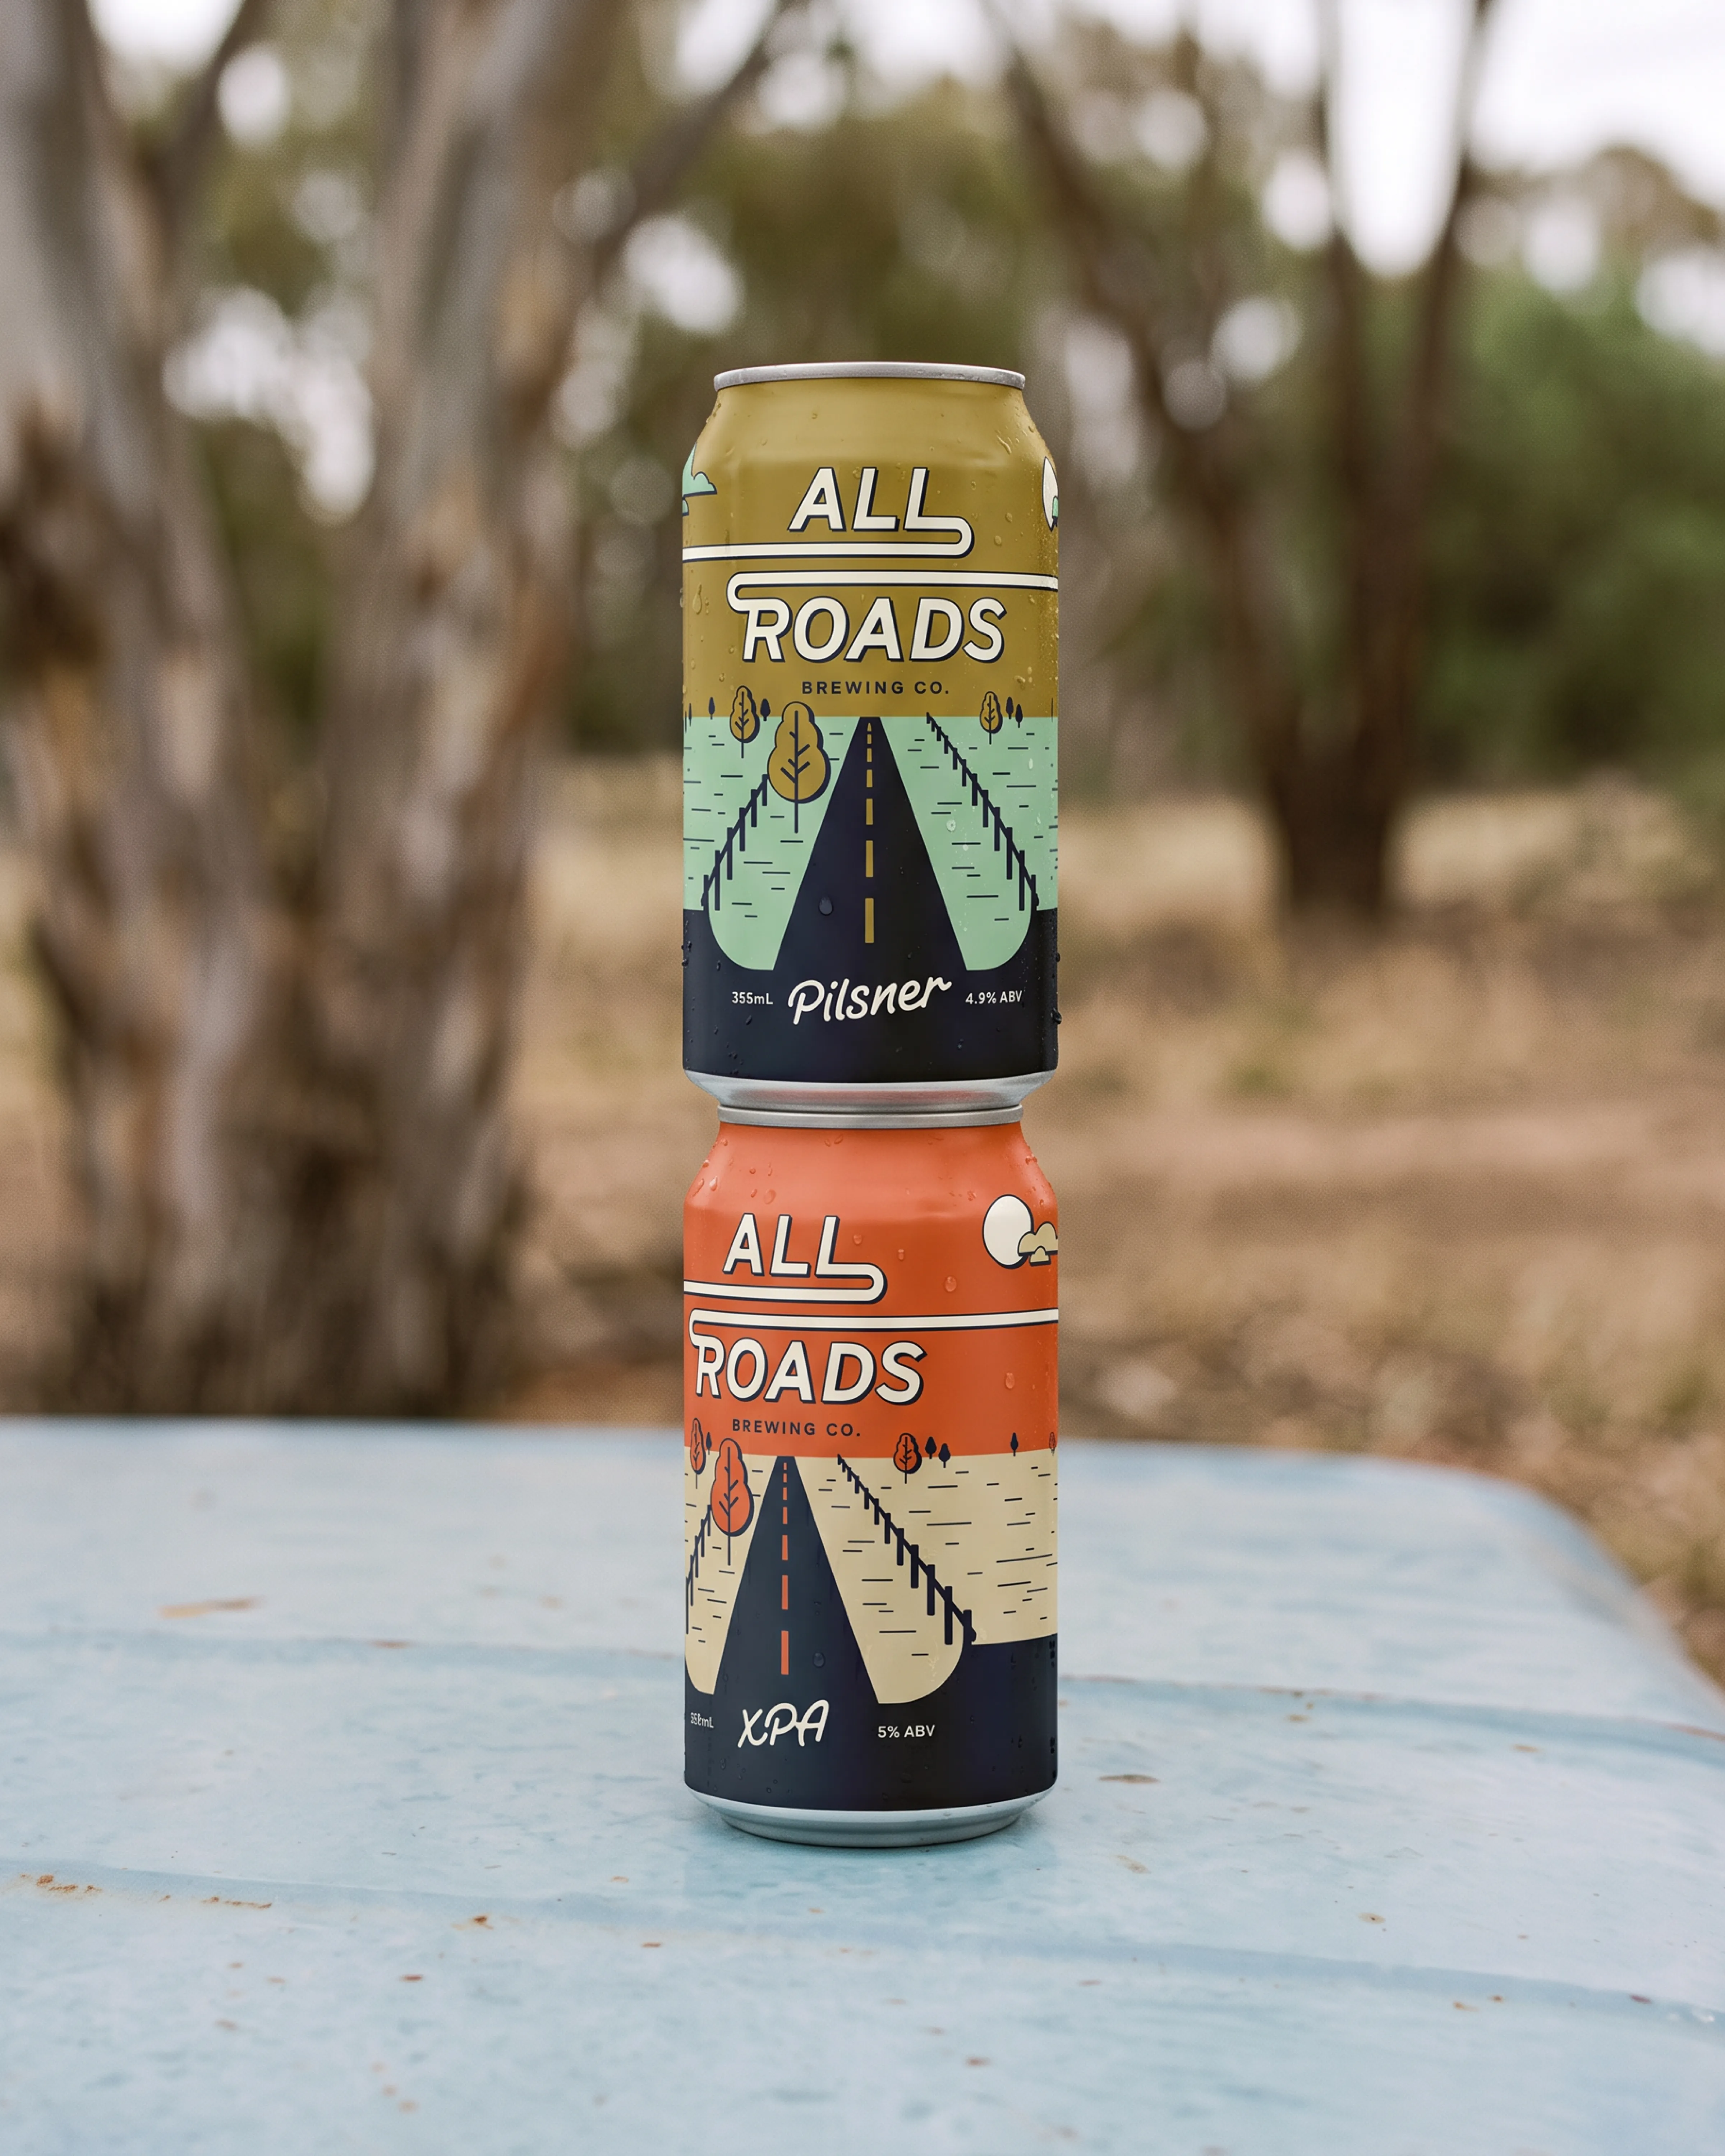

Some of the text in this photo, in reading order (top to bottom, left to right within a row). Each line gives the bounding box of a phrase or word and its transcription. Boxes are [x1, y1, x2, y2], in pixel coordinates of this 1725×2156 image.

[787, 467, 974, 544] ALL
[727, 588, 1007, 663] ROADS
[802, 681, 949, 695] BREWING CO.
[732, 991, 773, 1005] 355mL
[787, 977, 952, 1025] Pilsner
[965, 990, 1023, 1005] 4.9% ABV
[722, 1212, 888, 1289] ALL
[689, 1322, 927, 1406] ROADS
[732, 1418, 860, 1437] BREWING CO.
[737, 1699, 829, 1749] XPA
[878, 1724, 936, 1738] 5% ABV
